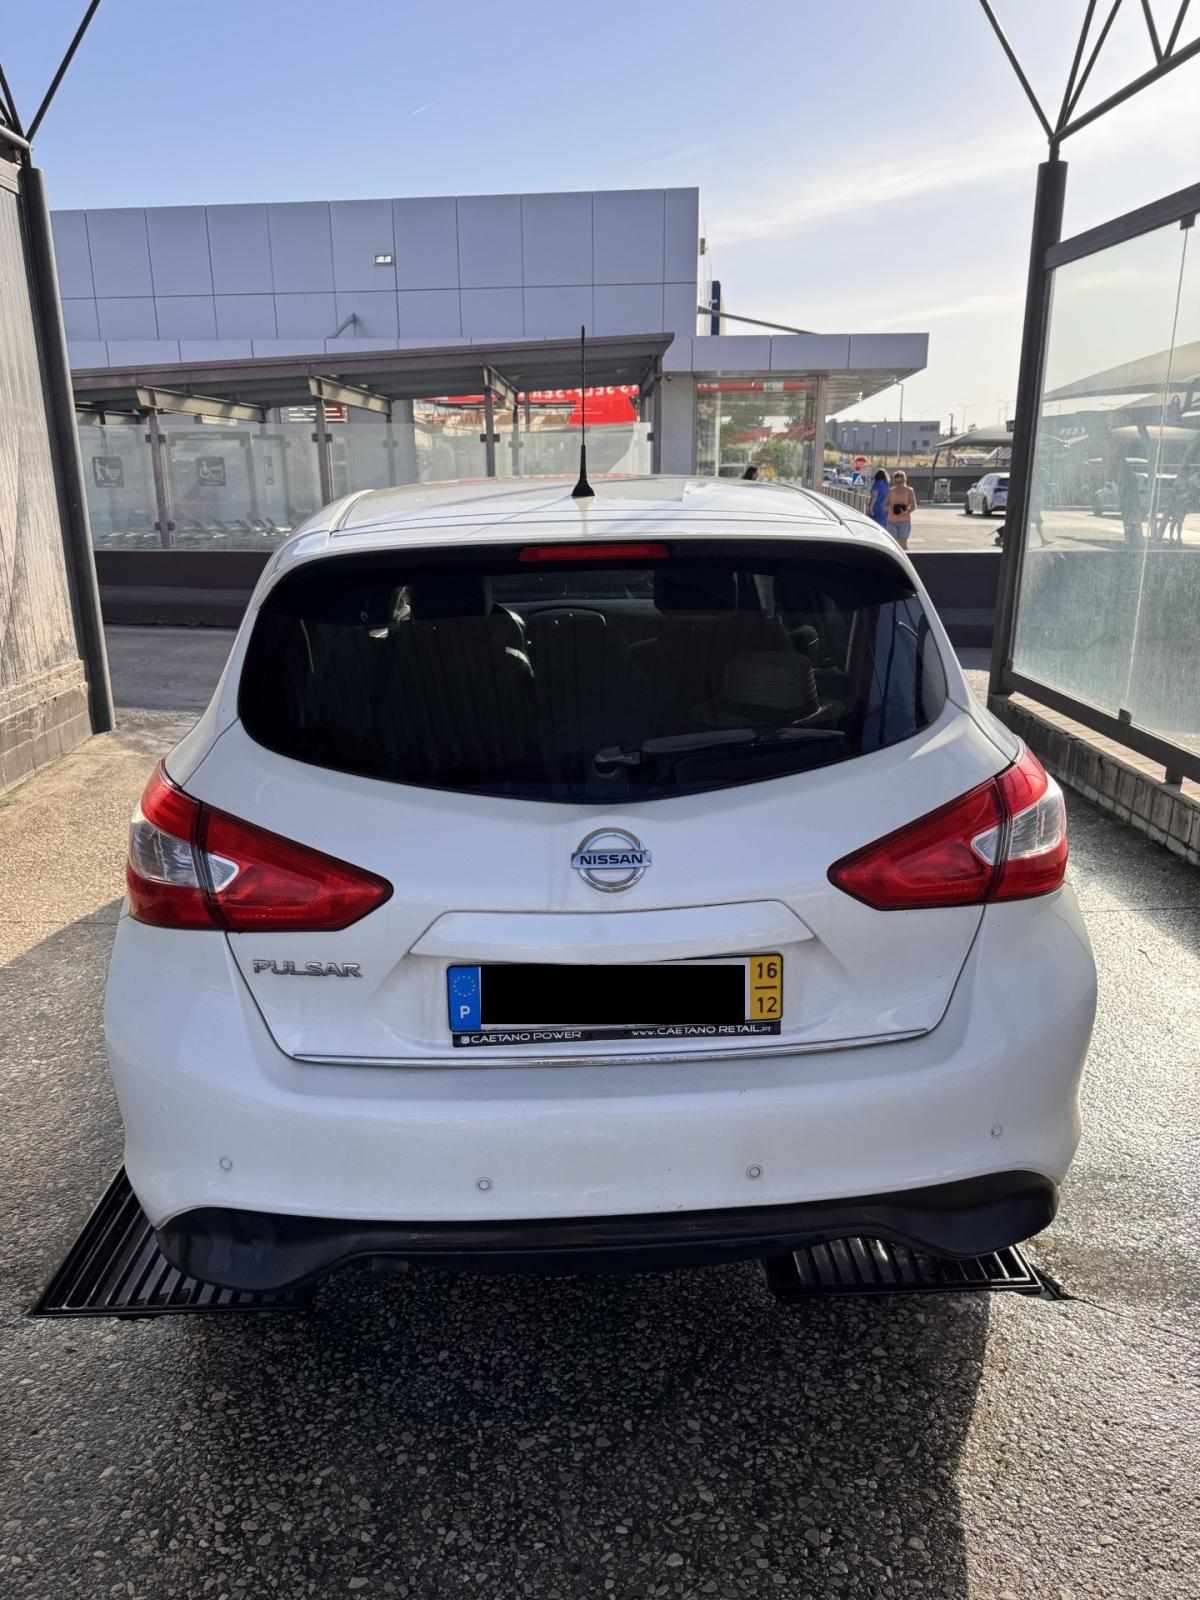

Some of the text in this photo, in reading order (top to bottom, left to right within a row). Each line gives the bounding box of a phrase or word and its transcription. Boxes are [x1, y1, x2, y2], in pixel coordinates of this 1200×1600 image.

[579, 854, 643, 865] NISSAN
[252, 959, 363, 978] PULSAR
[757, 962, 777, 979] 16
[459, 1004, 471, 1019] P
[757, 996, 777, 1014] 12
[471, 1031, 582, 1044] CAETANO POWER
